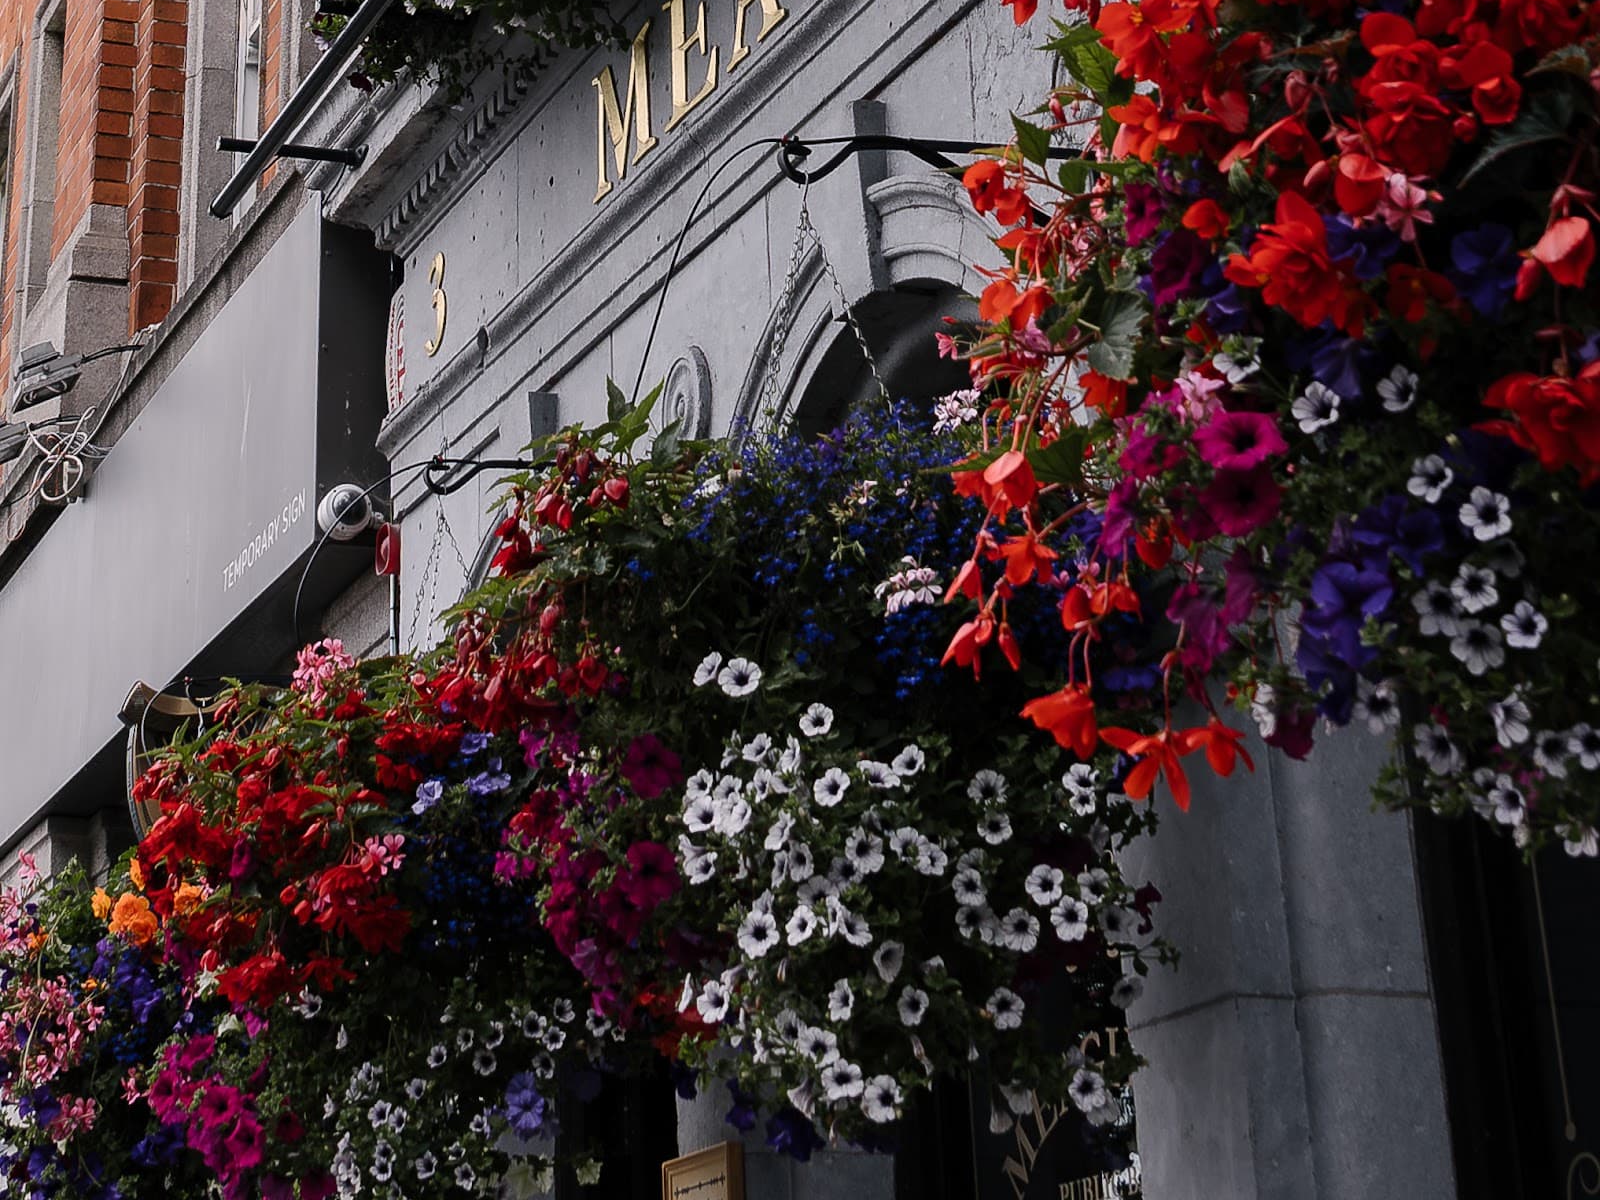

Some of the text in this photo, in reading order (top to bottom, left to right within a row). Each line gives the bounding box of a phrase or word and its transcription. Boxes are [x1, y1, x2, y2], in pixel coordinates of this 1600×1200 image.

[424, 251, 448, 358] 3
[222, 487, 306, 592] TEMPORARY SIGN
